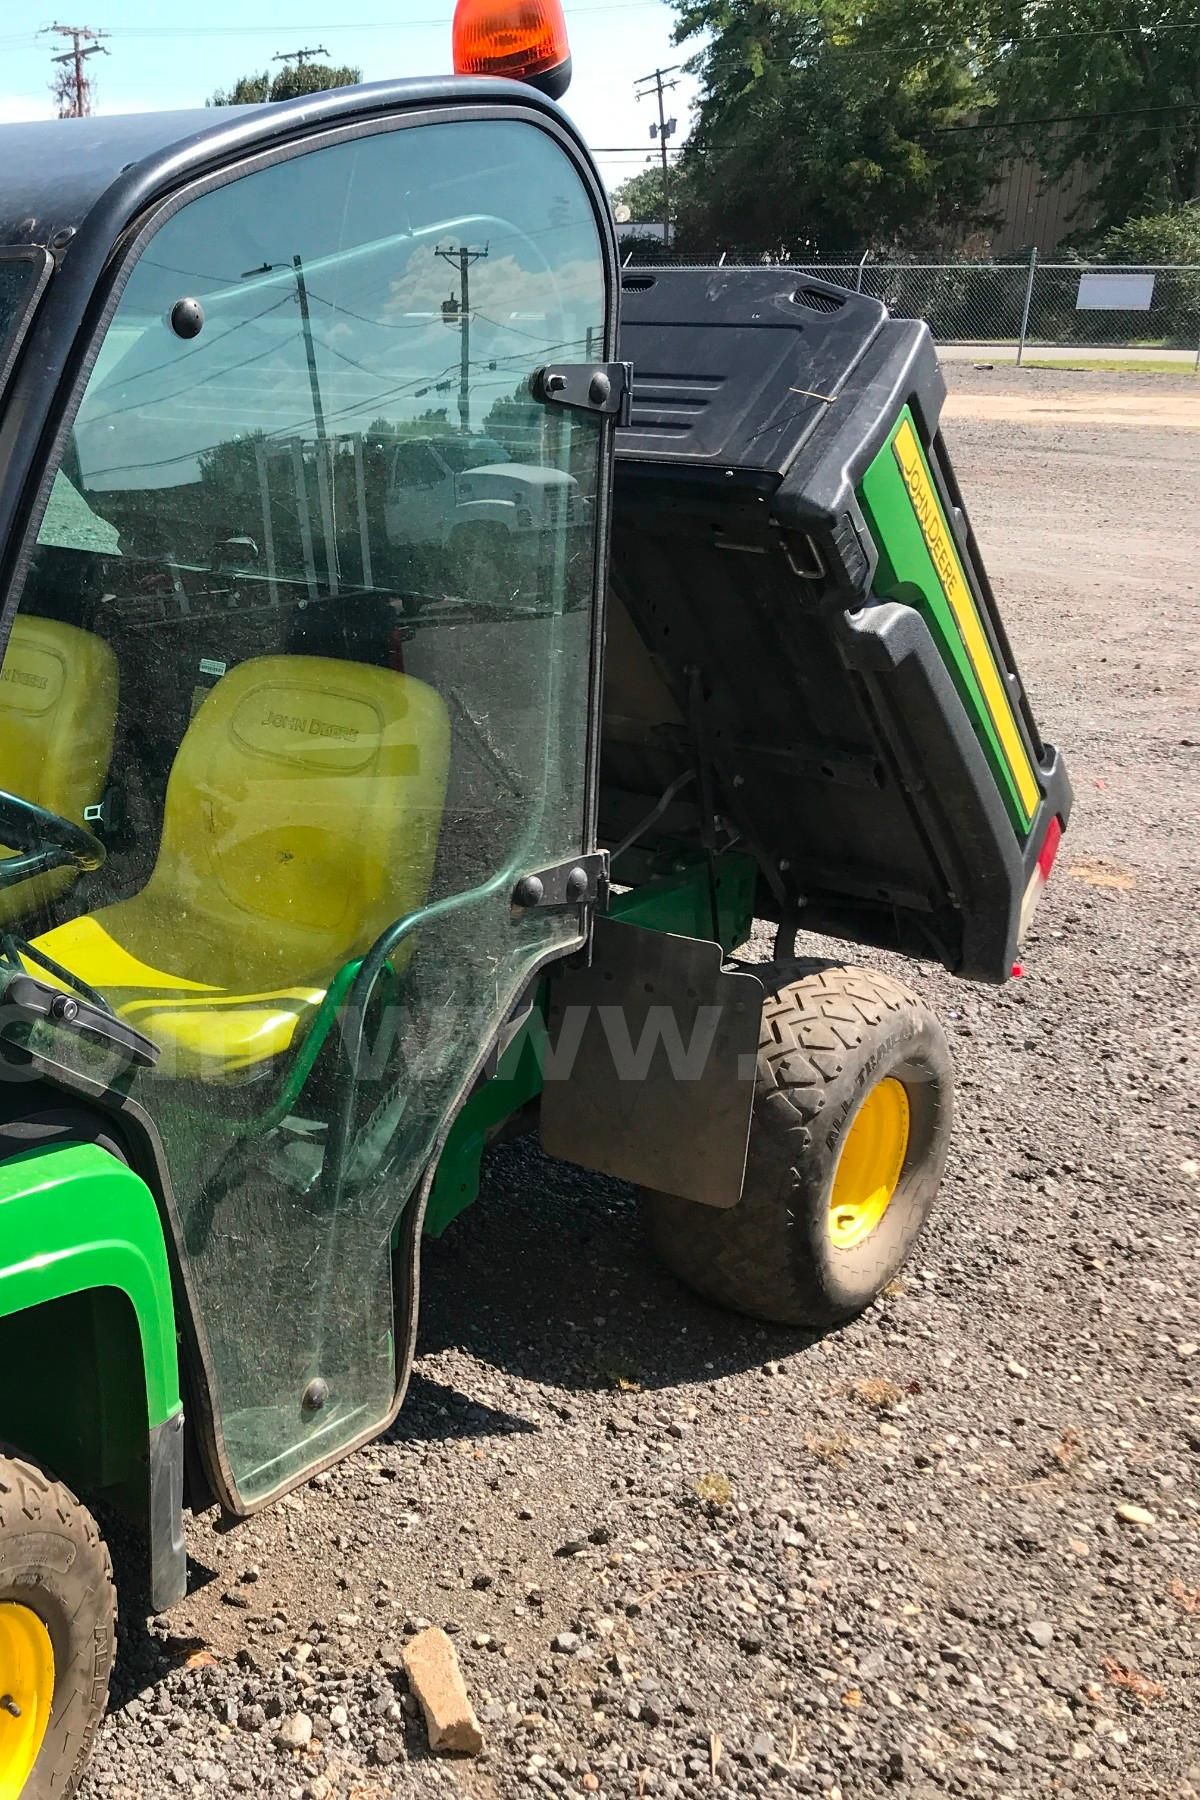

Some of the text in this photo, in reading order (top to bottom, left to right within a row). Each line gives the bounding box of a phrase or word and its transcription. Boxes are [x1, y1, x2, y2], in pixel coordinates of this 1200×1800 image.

[905, 458, 958, 597] JOHN DEERE
[261, 710, 360, 744] JOHN DEERE
